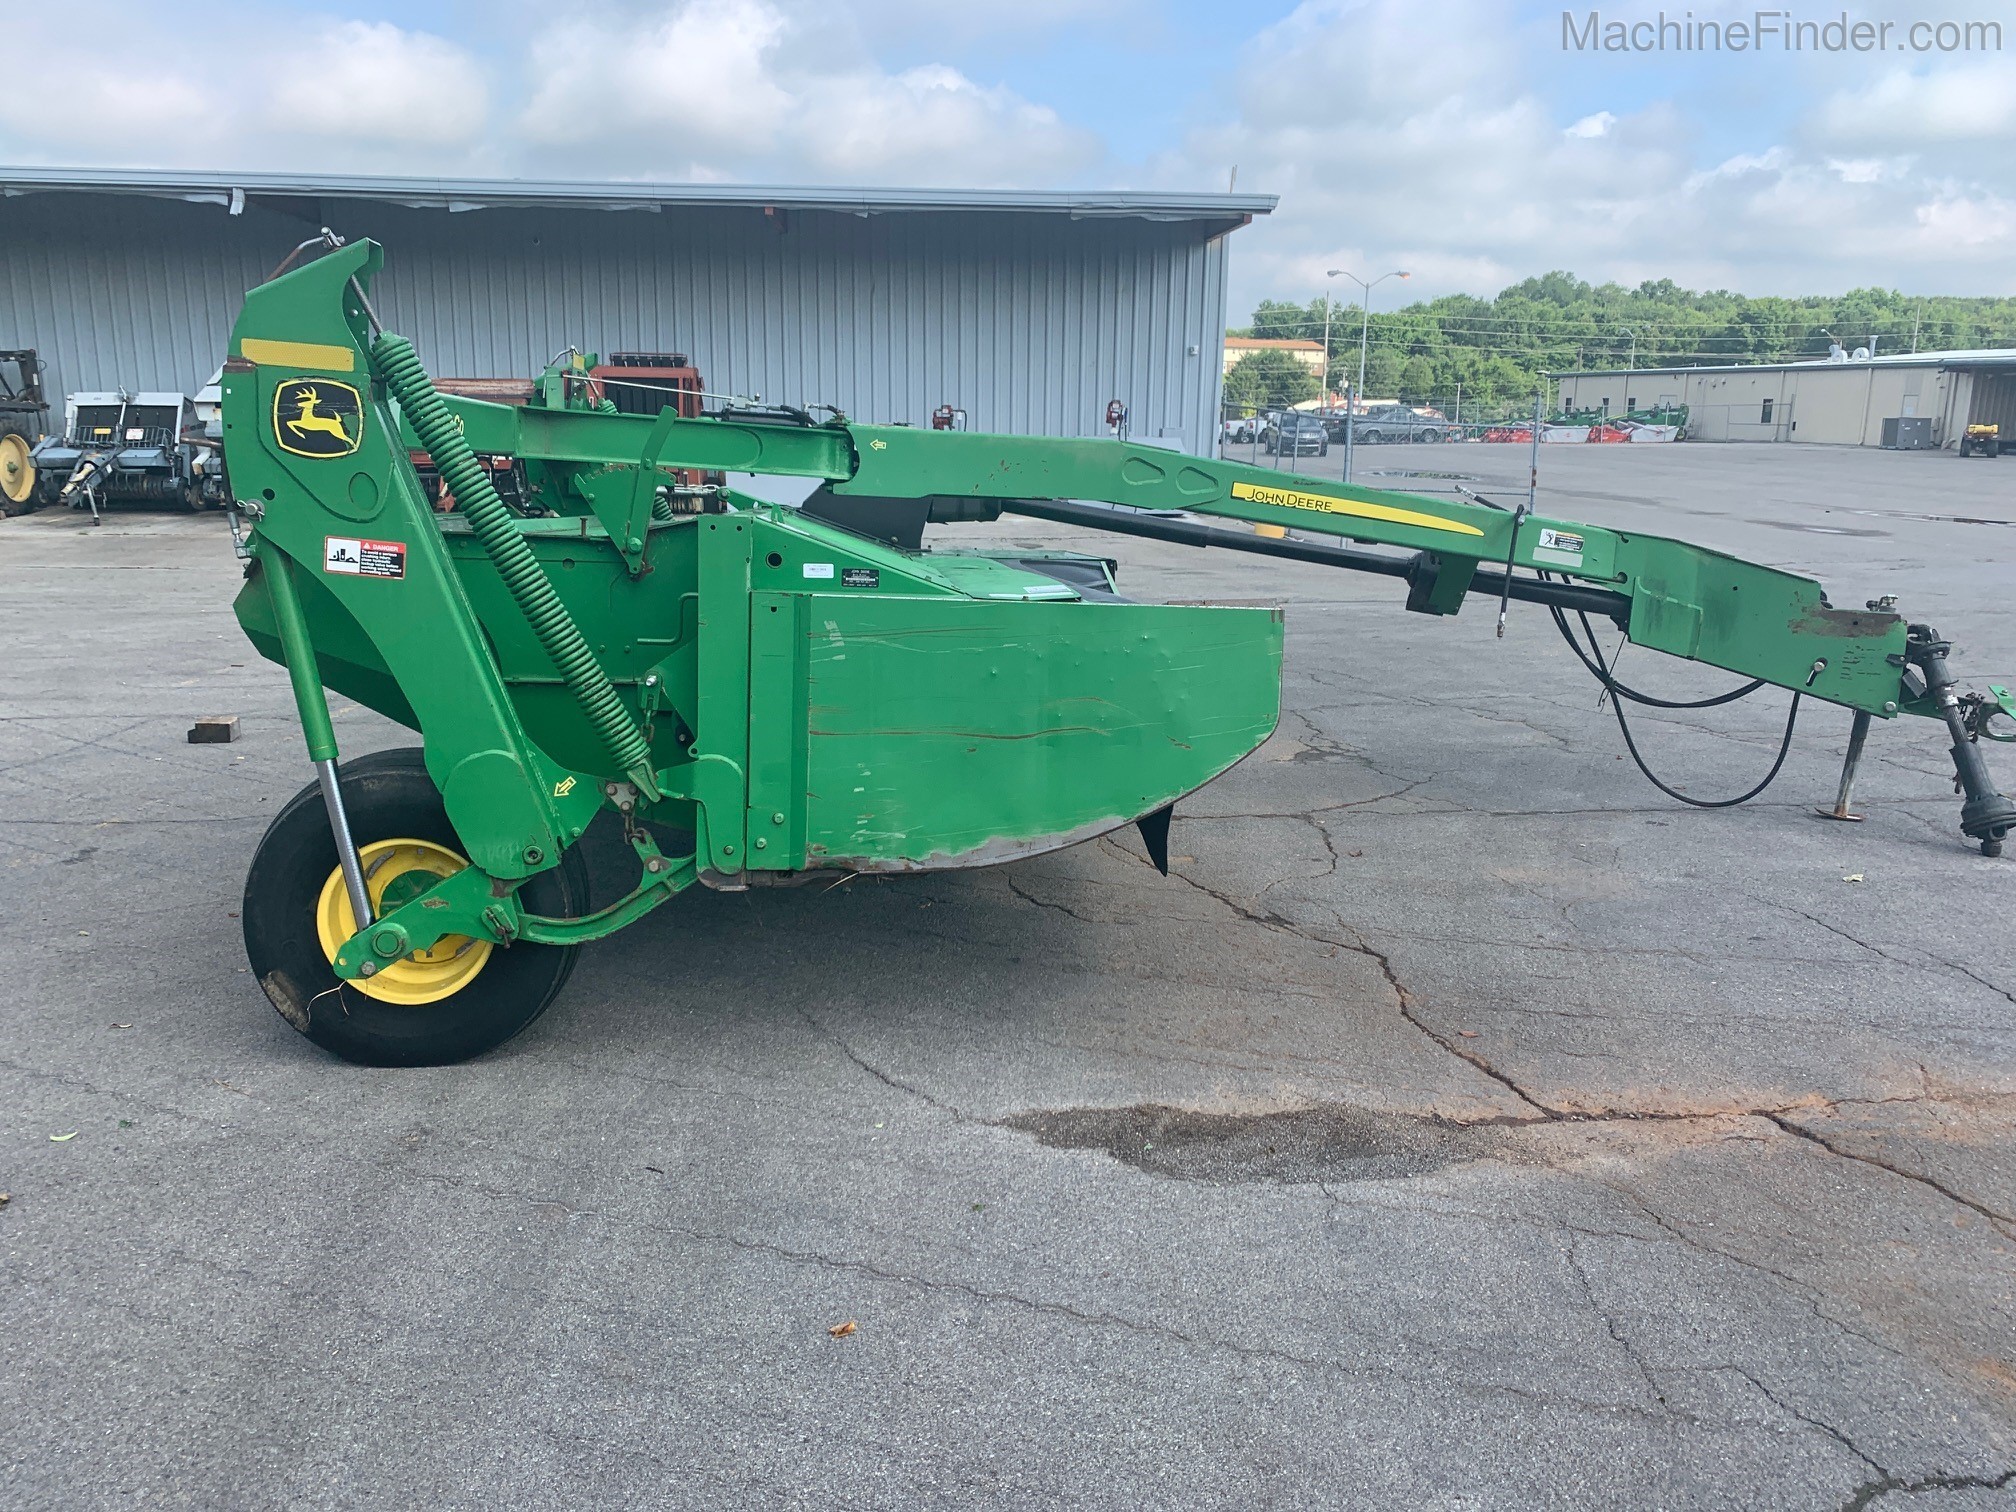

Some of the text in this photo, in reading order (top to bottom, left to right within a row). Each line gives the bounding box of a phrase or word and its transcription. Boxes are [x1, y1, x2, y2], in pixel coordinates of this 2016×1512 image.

[1246, 488, 1333, 511] JOHN DEERE
[372, 543, 399, 552] DANGER
